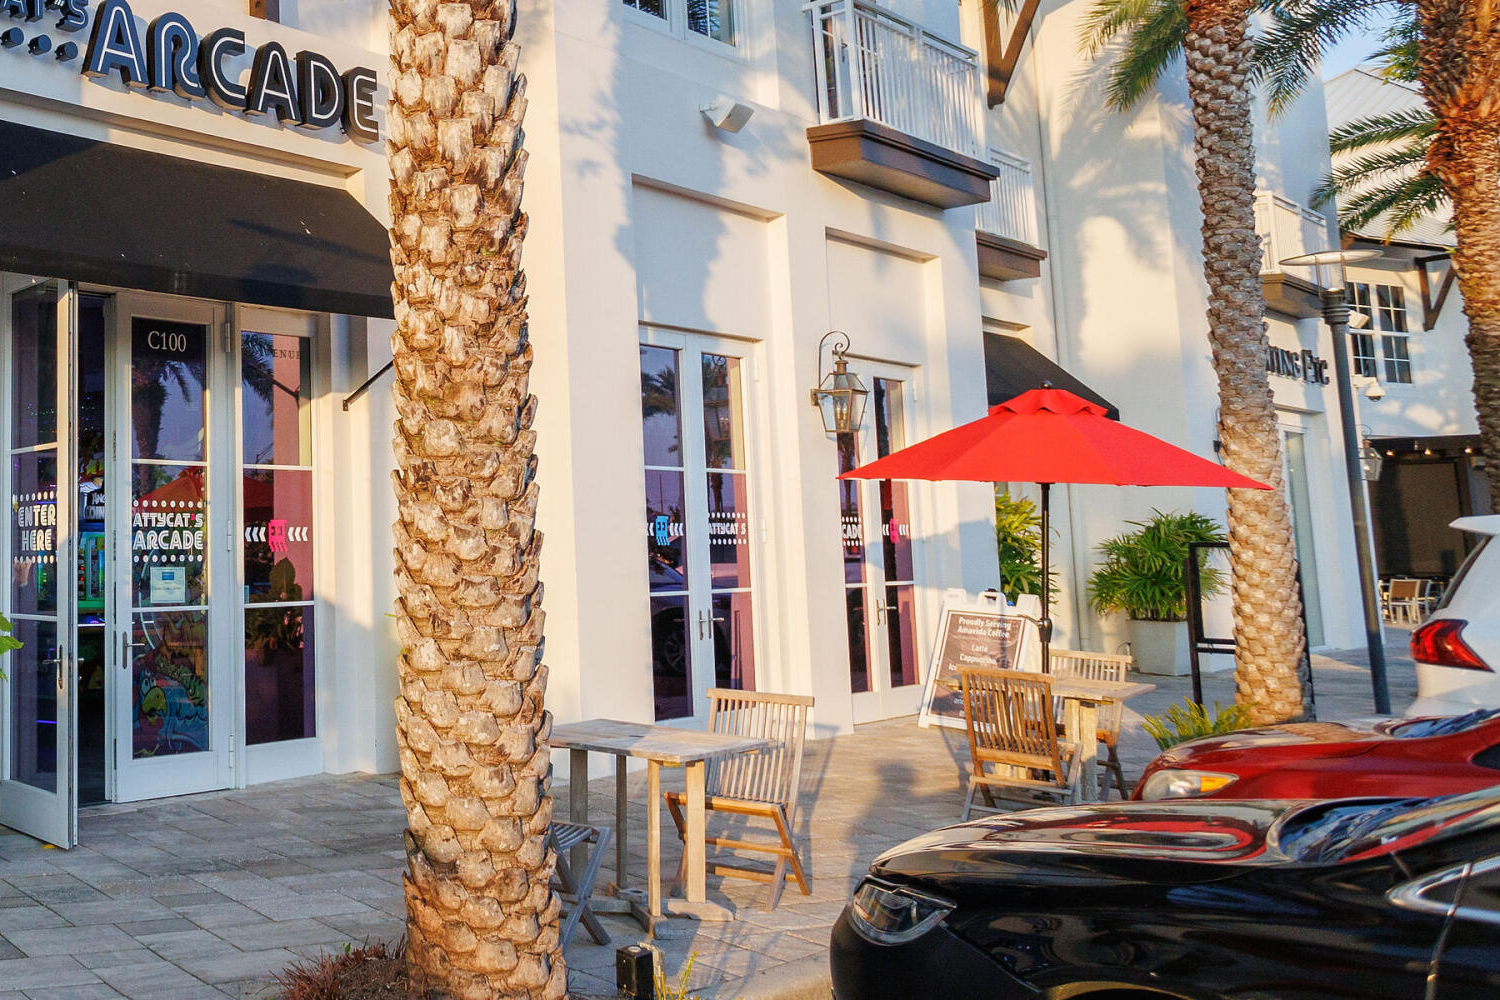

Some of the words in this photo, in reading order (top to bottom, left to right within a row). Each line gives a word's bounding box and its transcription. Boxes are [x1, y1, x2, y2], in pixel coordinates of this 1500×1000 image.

[147, 330, 187, 353] C100
[17, 503, 57, 528] ENTER
[132, 512, 204, 528] ATTYCAT'S
[21, 529, 52, 551] HERE
[132, 530, 204, 550] ARCADE
